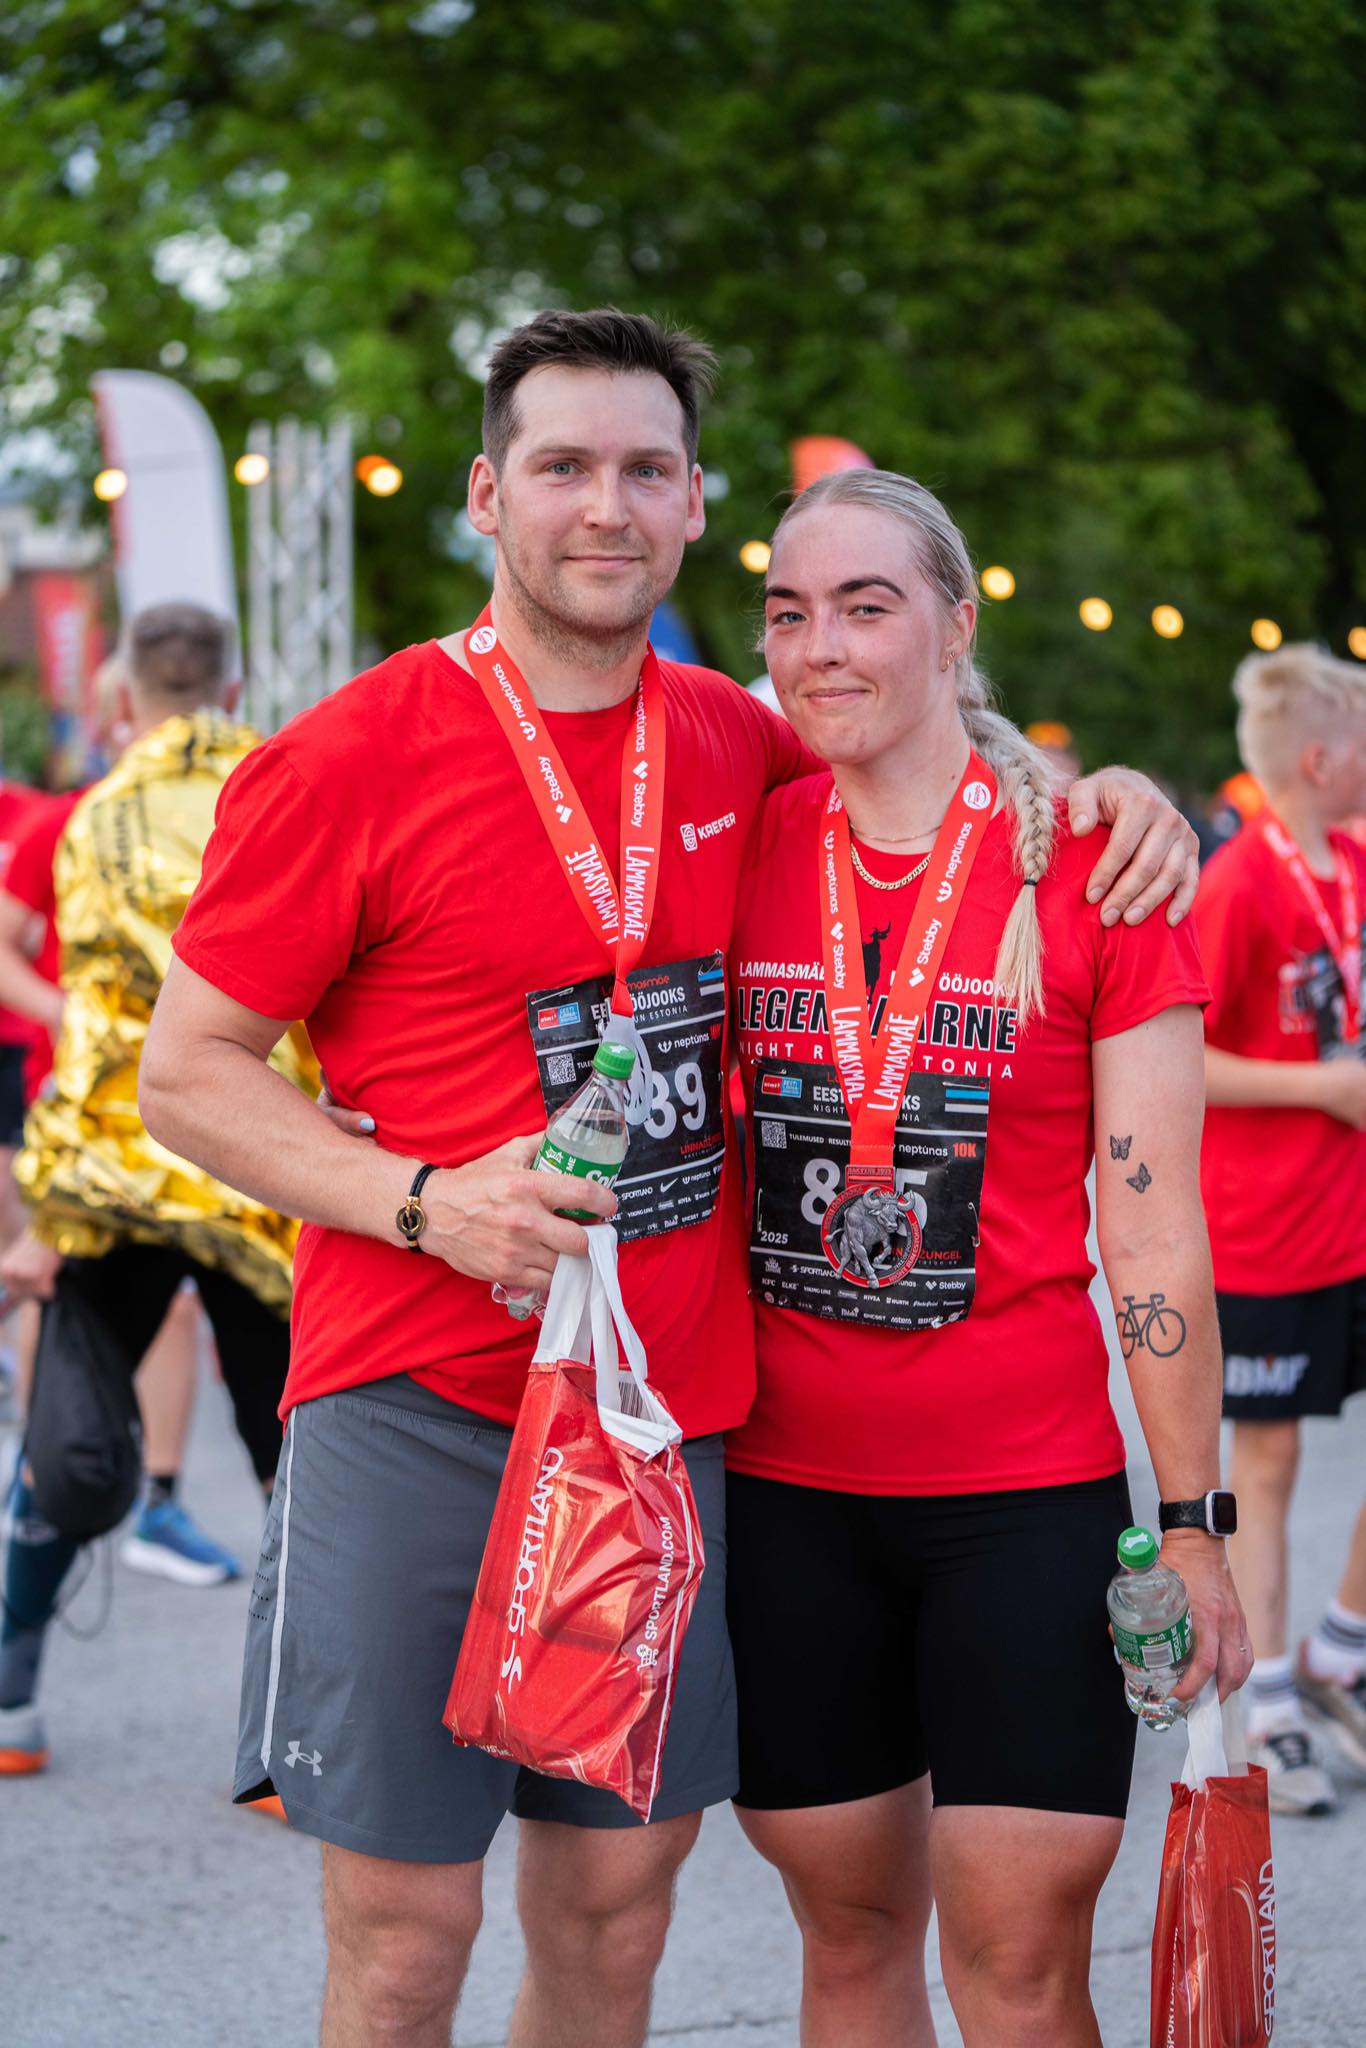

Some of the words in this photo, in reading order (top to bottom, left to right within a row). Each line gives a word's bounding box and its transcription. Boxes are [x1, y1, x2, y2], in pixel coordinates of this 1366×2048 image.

[537, 756, 564, 801] Stebby
[631, 782, 646, 828] Stebby
[697, 812, 736, 840] KAEFER
[917, 918, 943, 965] Stebby
[833, 943, 846, 989] Stebby
[650, 1005, 688, 1020] ESTONIA
[789, 1133, 825, 1144] TULEMUSED
[953, 1143, 977, 1158] 10K
[621, 1186, 654, 1201] SPORTLAND
[760, 1231, 789, 1245] 2025
[781, 1281, 798, 1290] ELKE
[939, 1281, 966, 1290] Stebby
[508, 1446, 564, 1636] SPORTLAND
[645, 1516, 674, 1640] SPORTLAND.COM
[1258, 1859, 1276, 2037] SPORTLAND
